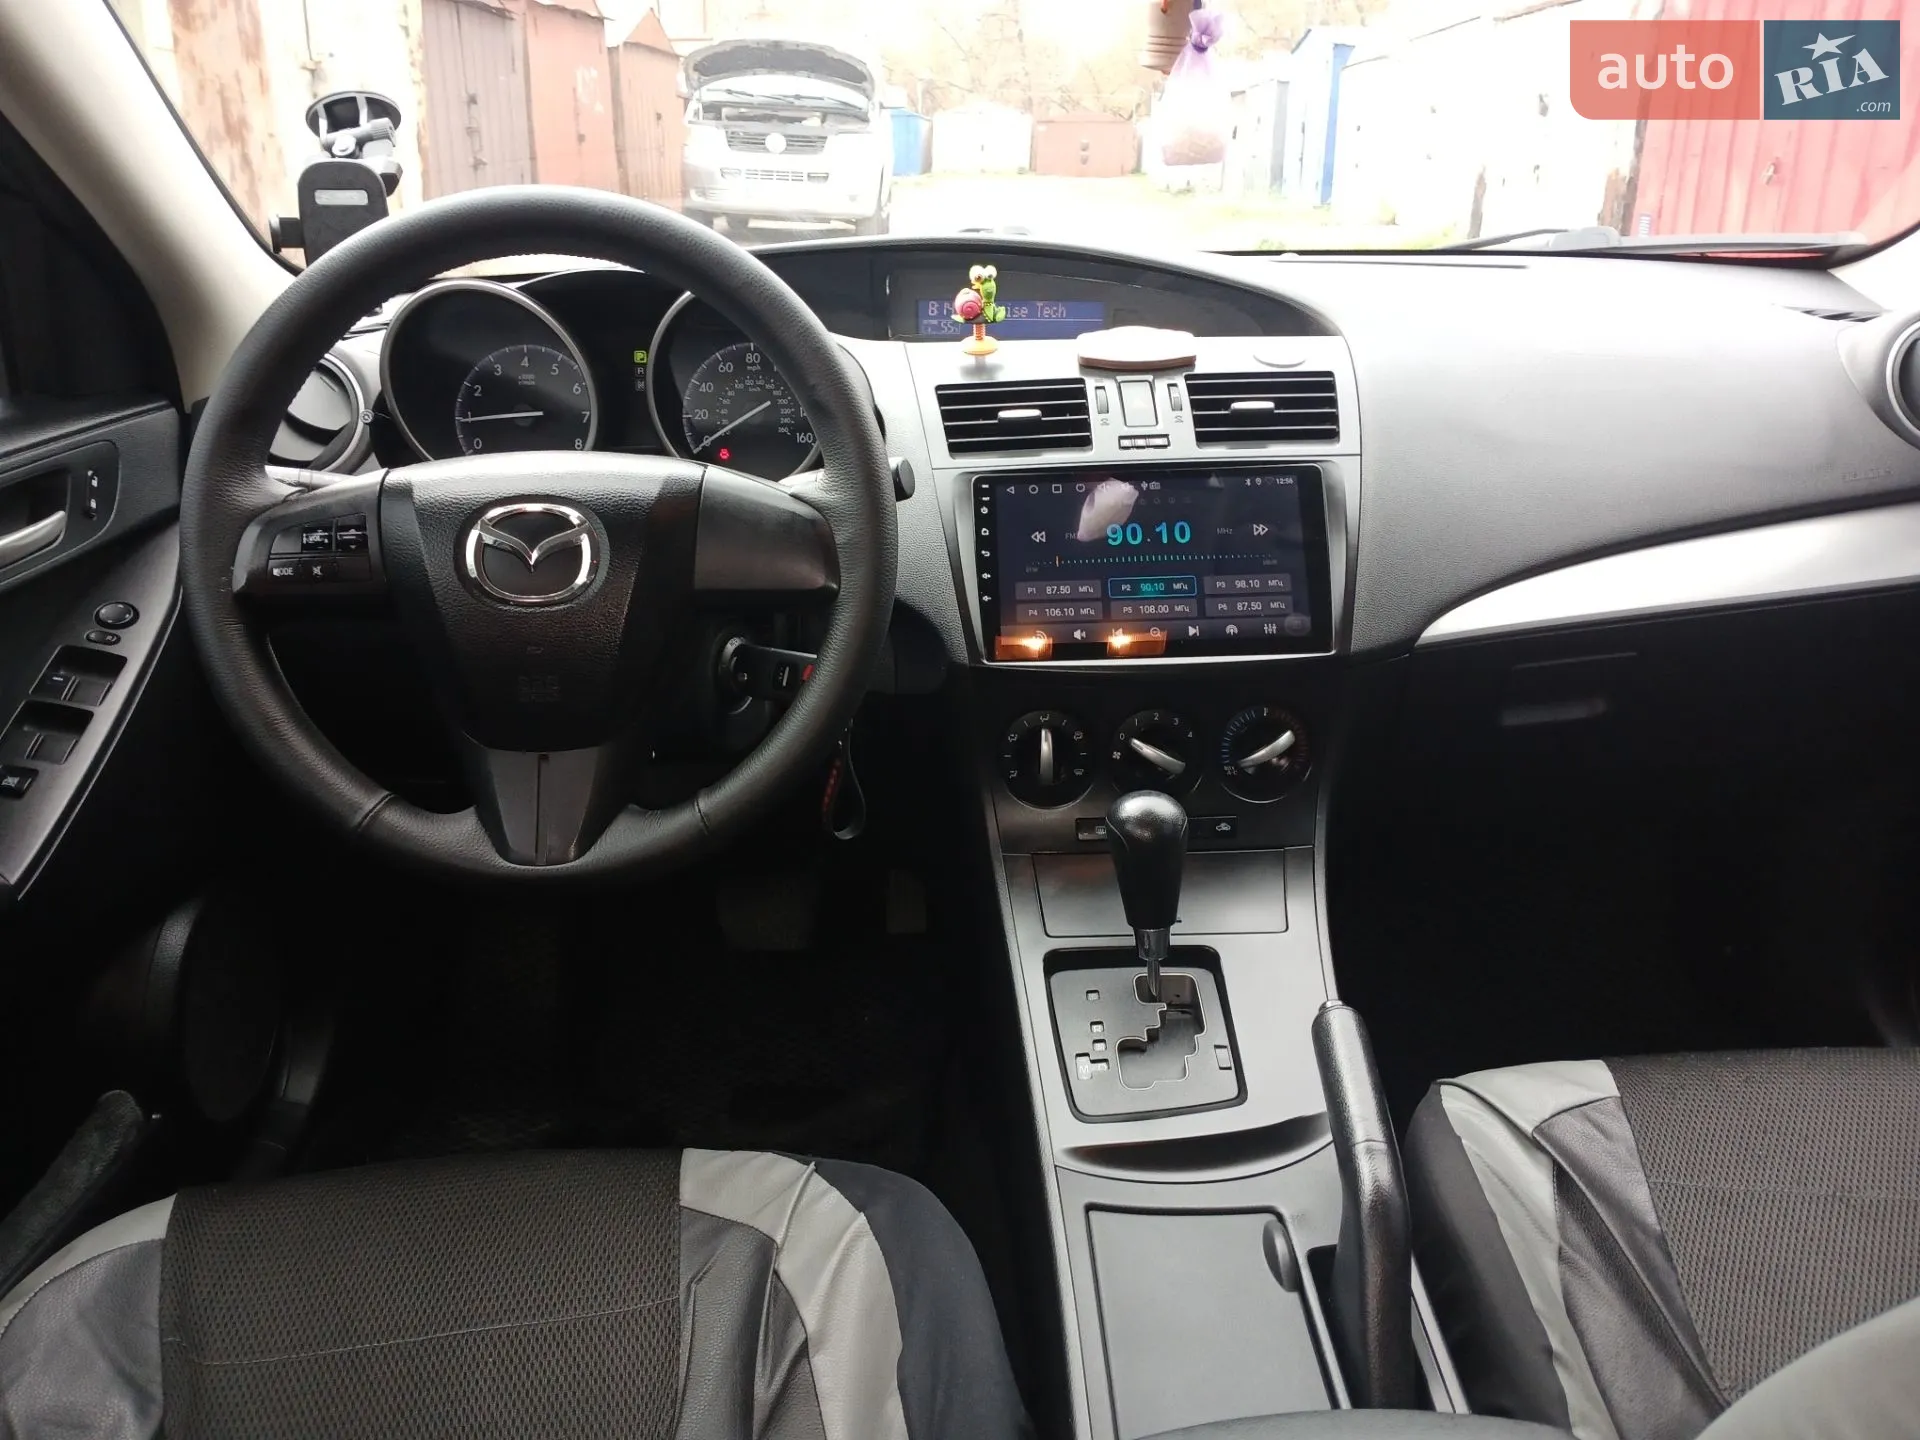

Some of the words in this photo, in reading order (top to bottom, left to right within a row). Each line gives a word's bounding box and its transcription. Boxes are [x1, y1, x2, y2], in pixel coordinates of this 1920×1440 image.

[1036, 302, 1067, 318] Tech
[520, 355, 529, 368] 4
[745, 352, 761, 364] 80
[493, 363, 502, 376] 3
[550, 363, 559, 376] 5
[718, 362, 734, 373] 60
[473, 384, 482, 397] 2
[572, 382, 582, 395] 6
[699, 382, 714, 393] 40
[581, 411, 590, 424] 7
[694, 409, 709, 420] 20
[796, 432, 814, 444] 160
[473, 438, 483, 450] 0
[574, 438, 583, 450] 8
[1106, 521, 1191, 546] 90.10
[1216, 527, 1233, 536] MHz
[272, 567, 294, 577] MODE
[1121, 584, 1132, 592] P2
[1140, 583, 1165, 592] 90.10
[1216, 580, 1226, 588] P3
[1235, 580, 1260, 588] 98.10
[1268, 579, 1284, 587] МГц
[1027, 587, 1037, 595] P1
[1046, 586, 1071, 595] 87.50
[1123, 606, 1133, 614] P5
[1139, 605, 1169, 614] 108.00
[1174, 604, 1190, 613] МГц
[1237, 602, 1262, 611] 87.50
[1270, 601, 1286, 609] МГц
[1045, 608, 1075, 617] 106.10
[1154, 712, 1160, 721] 2
[1173, 717, 1179, 726] 3
[1119, 732, 1126, 741] 0
